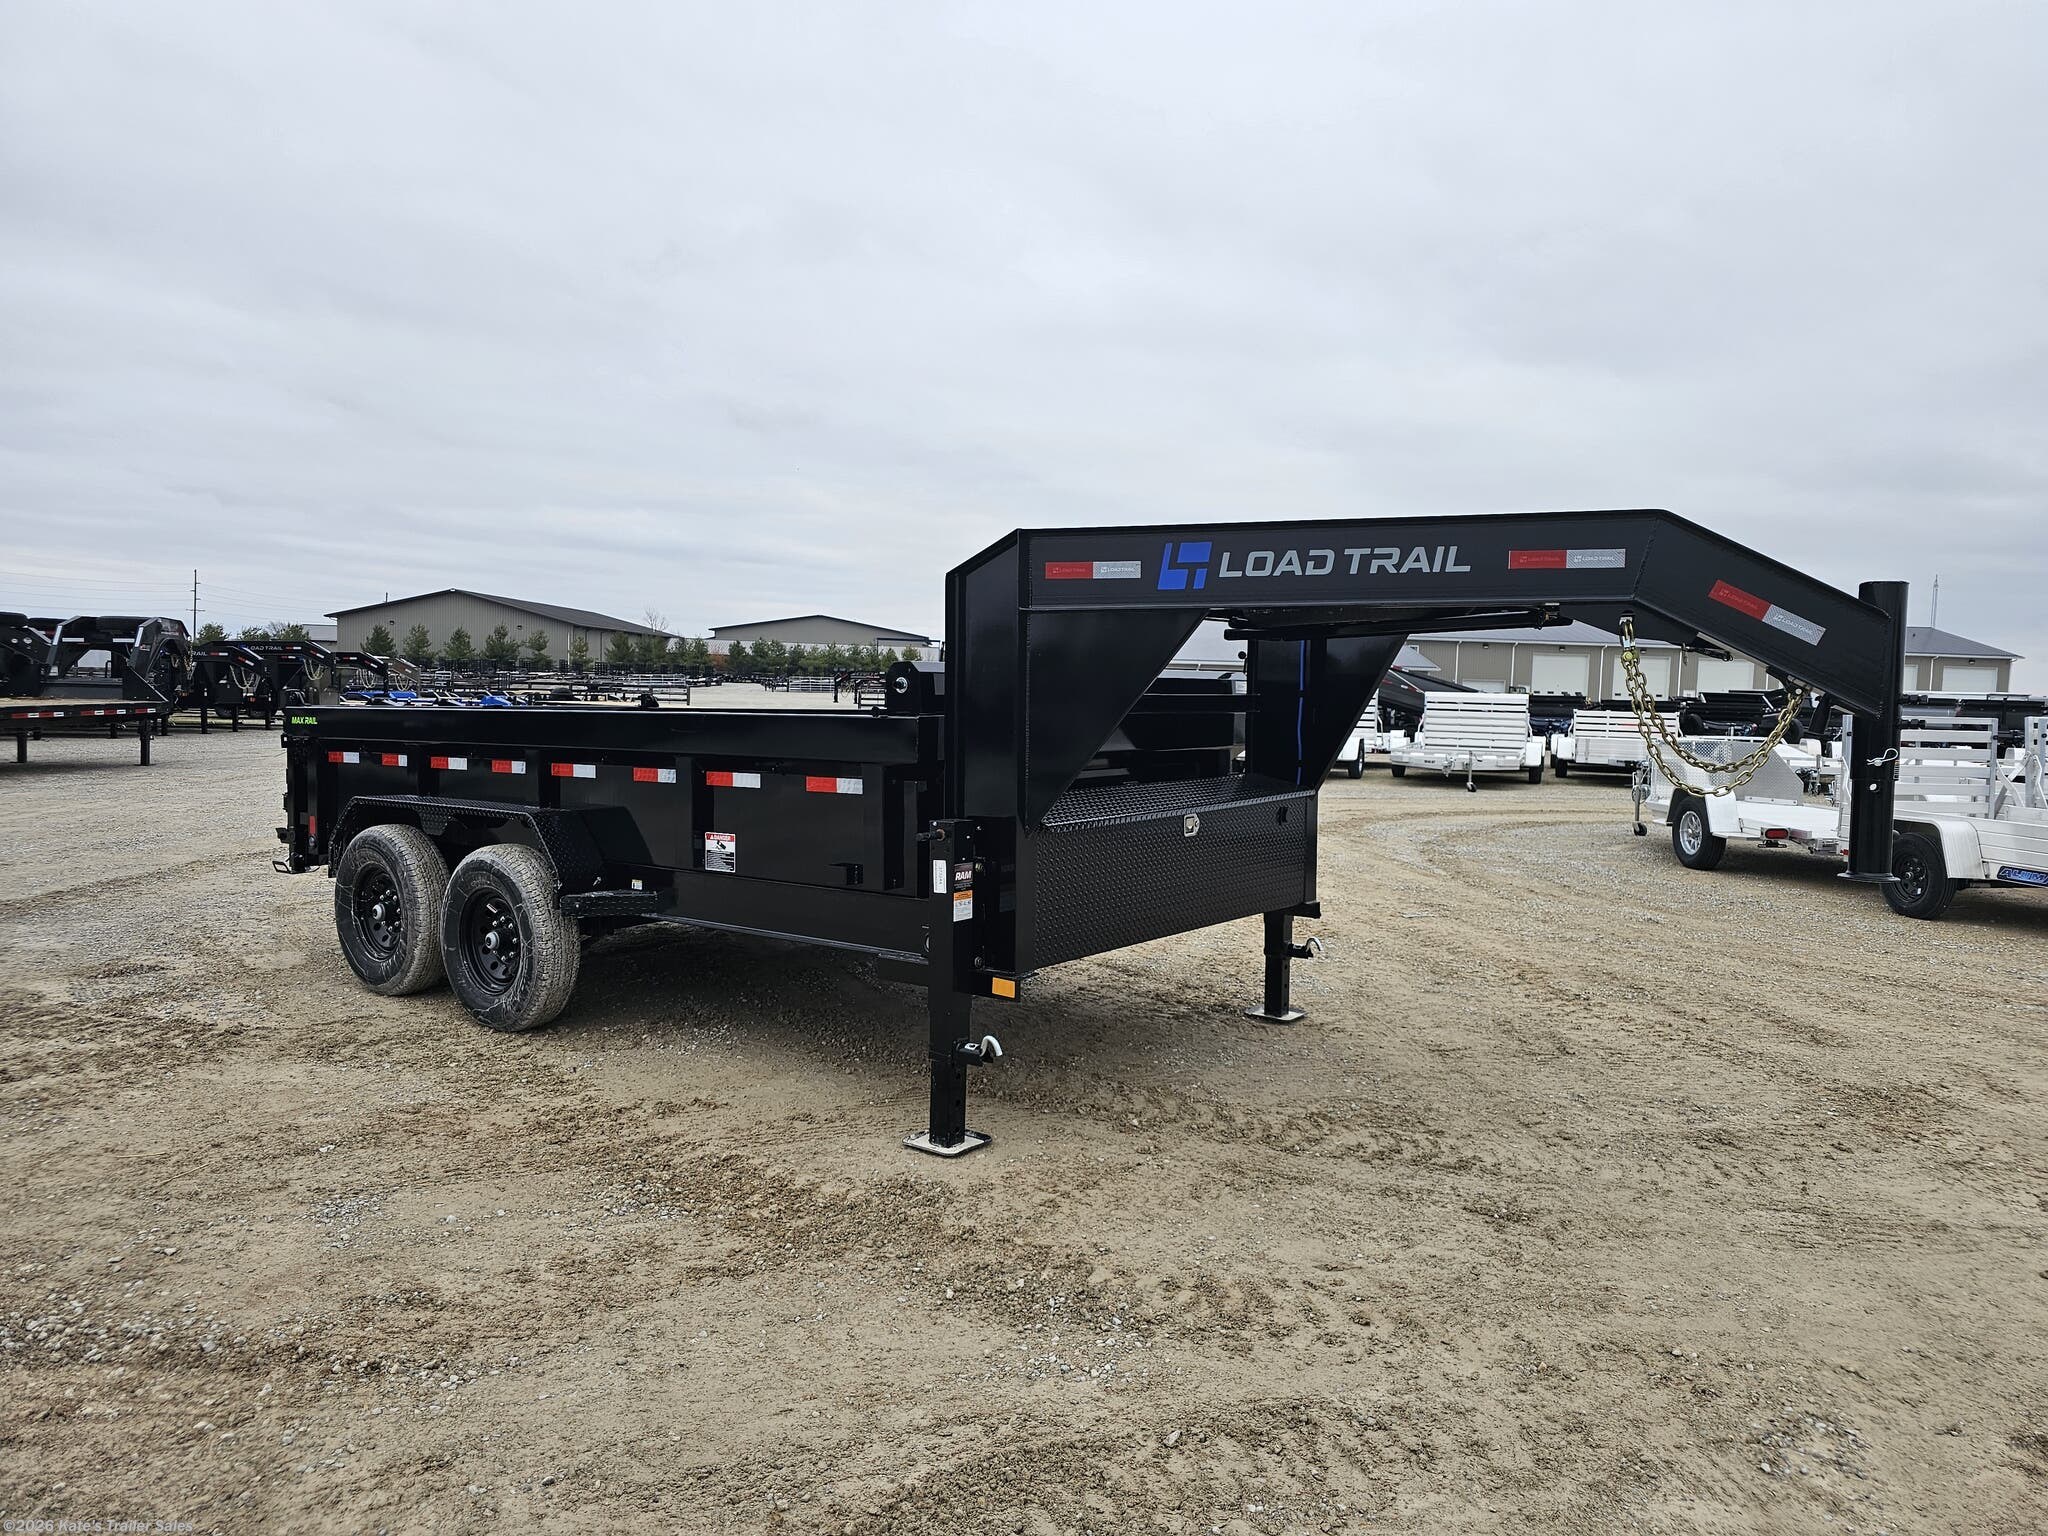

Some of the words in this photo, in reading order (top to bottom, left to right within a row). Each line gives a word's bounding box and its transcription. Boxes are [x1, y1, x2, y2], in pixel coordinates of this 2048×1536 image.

[1219, 550, 1335, 578] LOAD
[1344, 546, 1471, 575] TRAIL
[291, 716, 304, 724] MAX
[304, 716, 318, 724] RAIL
[955, 871, 972, 881] RAM
